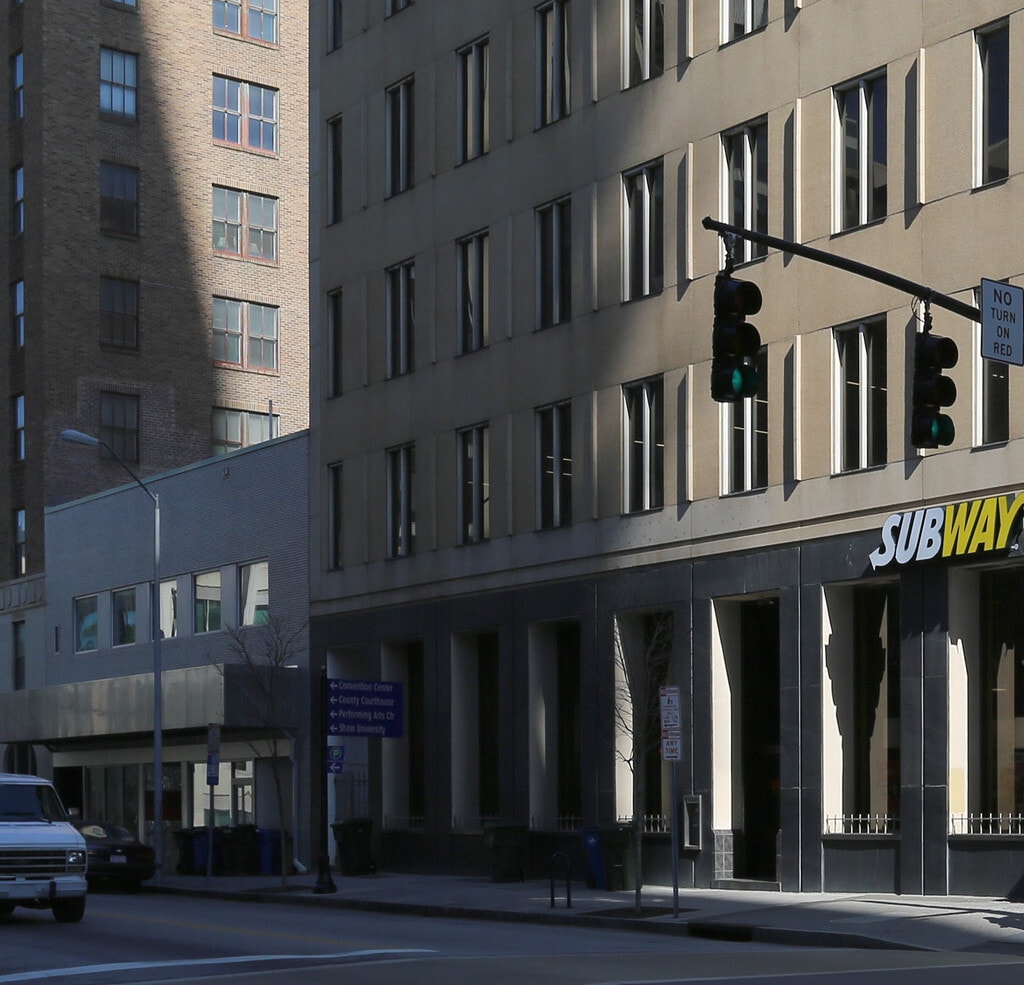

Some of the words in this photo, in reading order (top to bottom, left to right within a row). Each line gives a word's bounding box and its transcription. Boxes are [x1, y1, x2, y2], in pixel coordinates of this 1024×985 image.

[993, 288, 1012, 306] NO
[990, 307, 1016, 324] TURN
[996, 325, 1010, 340] ON
[993, 342, 1013, 357] RED
[338, 681, 373, 691] Convention
[374, 683, 394, 692] Center
[338, 695, 360, 706] County
[361, 696, 395, 706] Courthouse
[338, 709, 372, 721] Performing
[373, 711, 385, 720] Arts
[338, 723, 356, 733] Shaw
[357, 725, 386, 735] University
